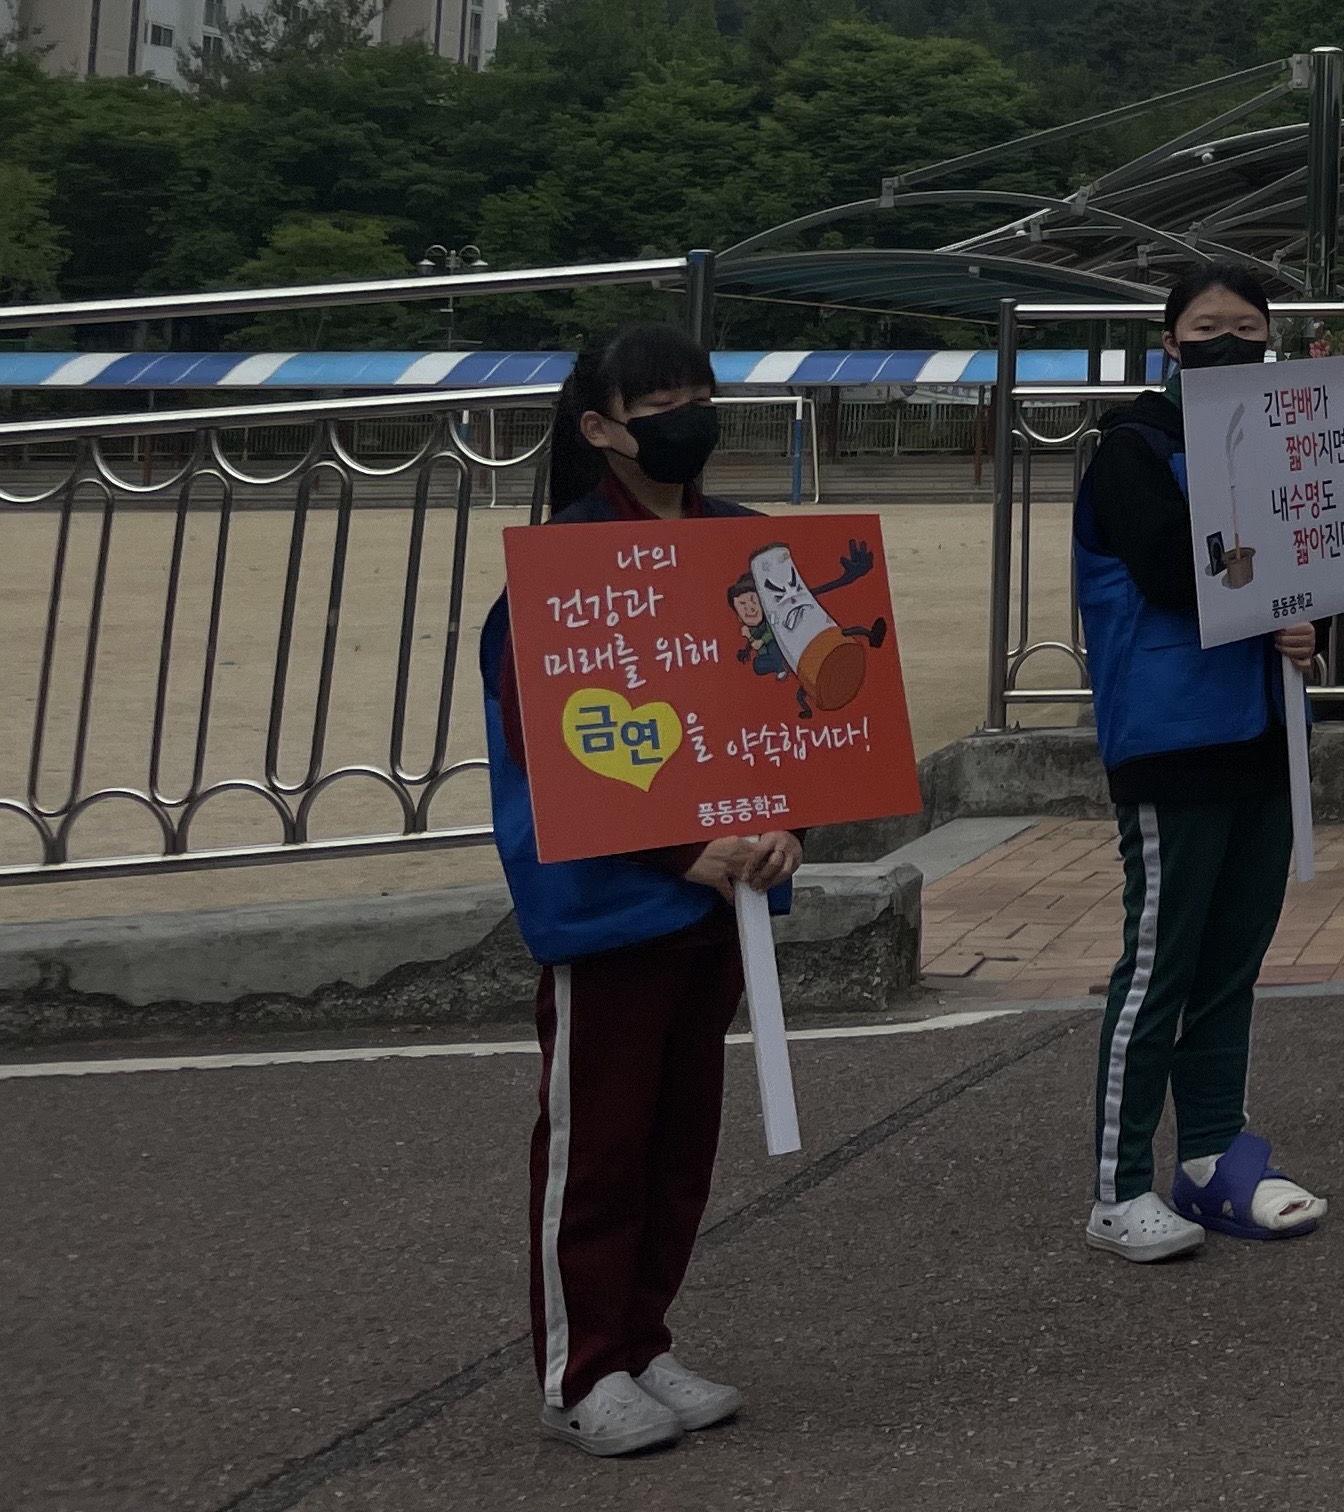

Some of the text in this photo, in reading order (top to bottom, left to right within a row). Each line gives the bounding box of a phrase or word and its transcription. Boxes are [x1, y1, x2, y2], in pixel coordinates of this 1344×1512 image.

[616, 544, 677, 571] 나의
[546, 585, 664, 629] 건강과
[1272, 592, 1313, 618] 풍동중학교
[544, 633, 720, 689] 미래를 위해
[726, 718, 871, 768] 약속합니다!
[698, 794, 790, 827] 풍동중학교
